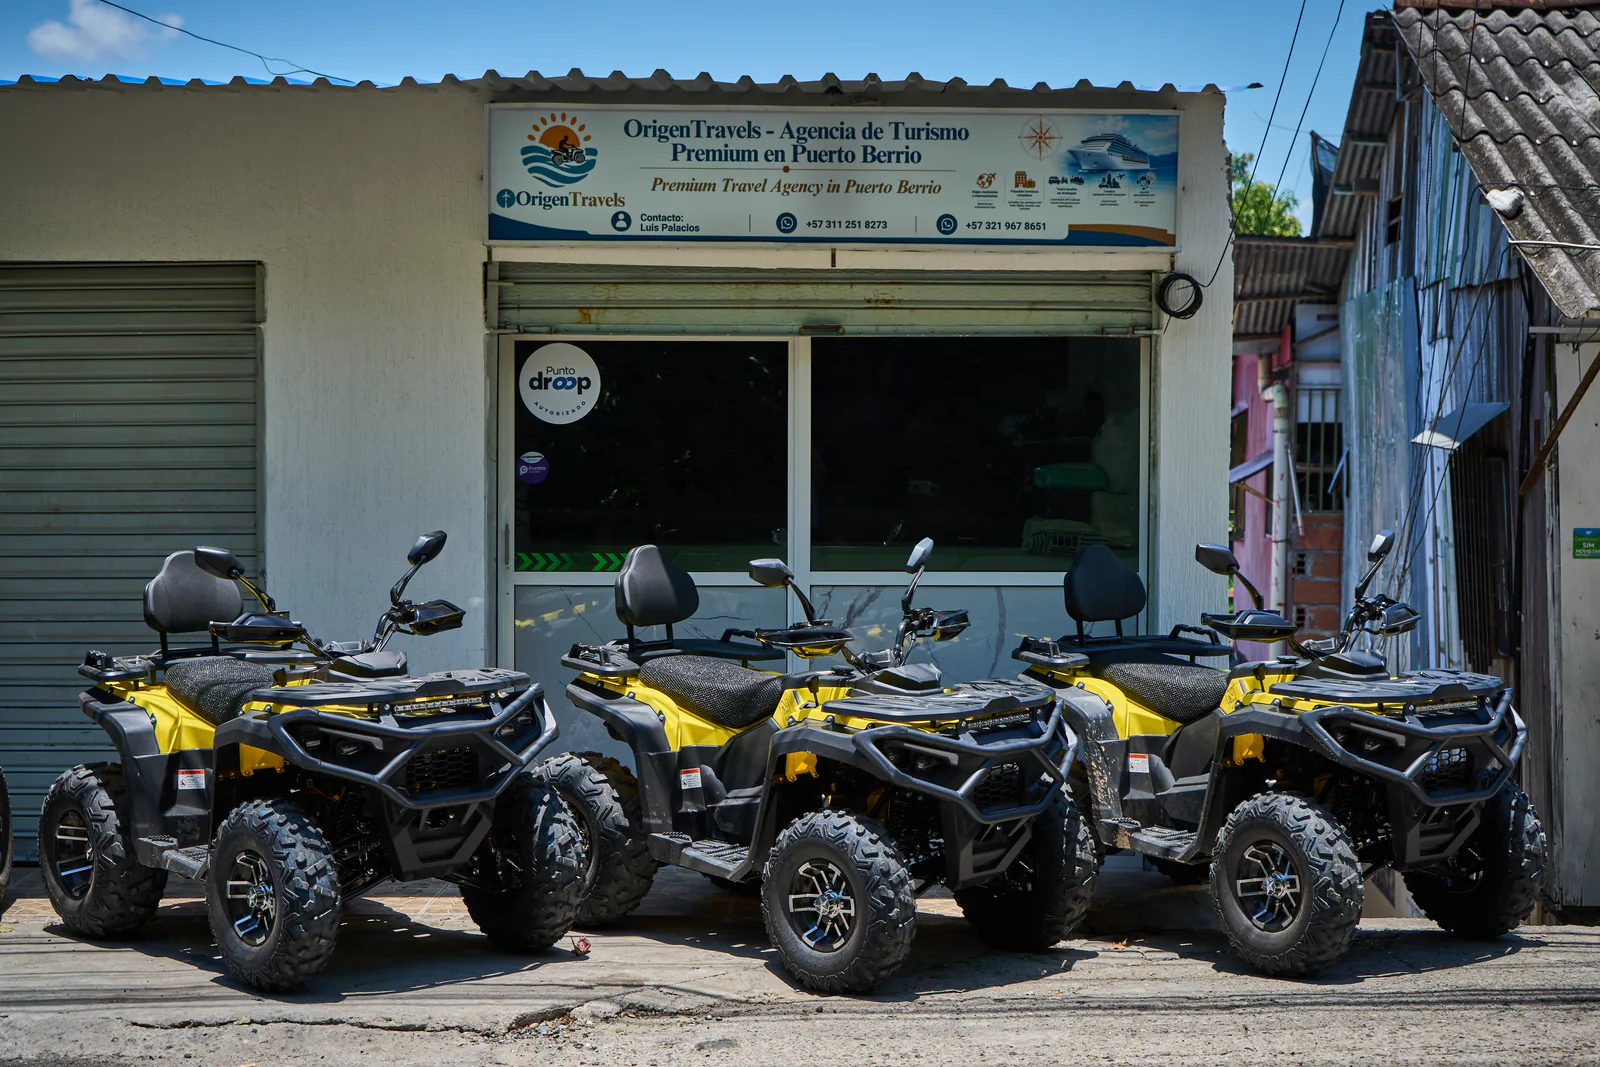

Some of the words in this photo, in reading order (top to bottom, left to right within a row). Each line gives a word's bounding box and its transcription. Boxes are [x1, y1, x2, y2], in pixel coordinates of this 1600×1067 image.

[623, 118, 762, 143] OrigenTravels
[779, 121, 856, 144] Agencia
[862, 122, 884, 140] de
[889, 121, 969, 141] Turismo
[670, 143, 758, 162] Premium
[764, 148, 785, 162] en
[791, 144, 856, 164] Puerto
[861, 145, 922, 164] Berrio
[651, 177, 717, 192] Premium
[722, 178, 768, 193] Travel
[770, 178, 823, 196] Agency
[827, 178, 841, 194] in
[844, 179, 893, 194] Puerto
[897, 179, 942, 194] Berrio
[516, 190, 626, 210] OrigenTravels
[640, 213, 684, 222] Contacto:
[806, 220, 824, 229] +57
[825, 220, 842, 229] 311
[845, 220, 861, 229] 251
[864, 220, 888, 229] 8273
[640, 223, 659, 232] Luis
[661, 223, 700, 232] Palacios
[965, 221, 983, 230] +57
[985, 221, 1001, 230] 321
[1005, 222, 1022, 230] 967
[1024, 222, 1046, 231] 8651
[546, 366, 576, 375] Punto
[529, 371, 592, 395] droop
[533, 401, 586, 416] AUTORIZADO
